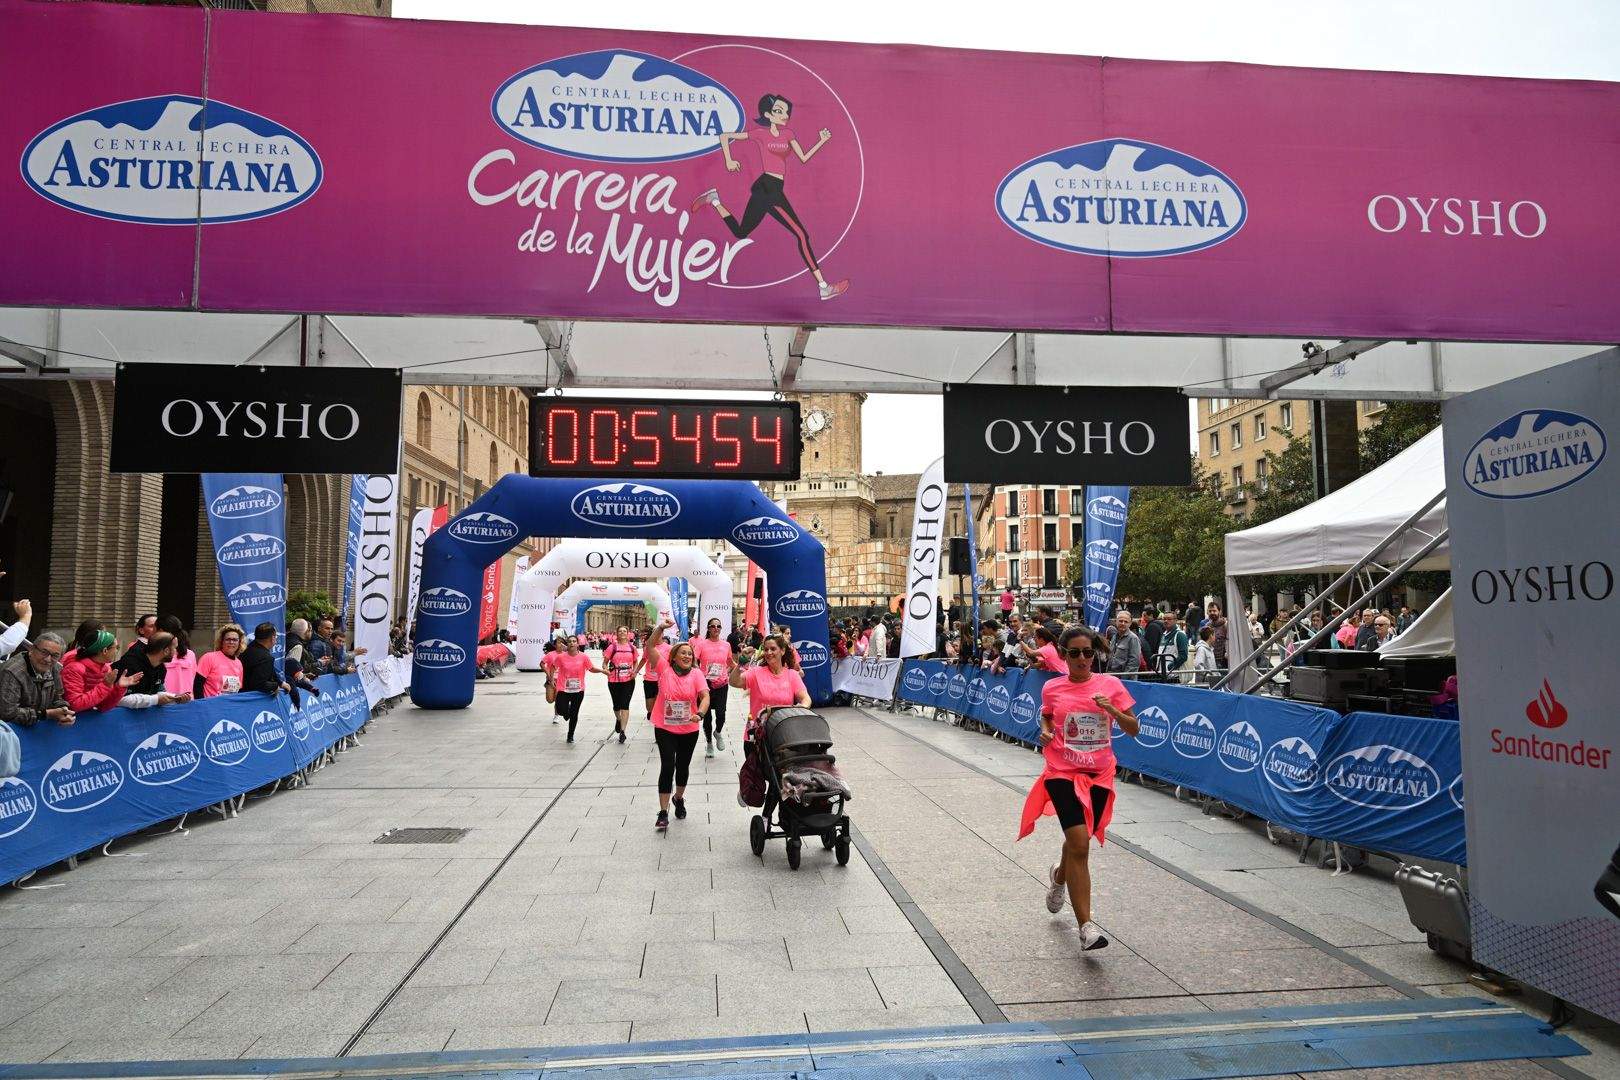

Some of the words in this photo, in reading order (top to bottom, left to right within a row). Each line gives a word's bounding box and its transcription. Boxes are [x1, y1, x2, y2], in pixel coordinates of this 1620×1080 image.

[552, 85, 631, 100] CENTRAL
[640, 90, 718, 104] LECHERA
[512, 86, 724, 137] ASTURIANA
[94, 137, 186, 153] CENTRAL
[195, 138, 291, 156] LECHERA
[44, 139, 299, 193] ASTURIANA
[467, 148, 678, 215] Carrera
[1055, 177, 1133, 191] CENTRAL
[1142, 180, 1219, 193] LECHERA
[1016, 179, 1229, 228] ASTURIANA
[1367, 193, 1548, 239] OYSHO
[518, 213, 557, 254] de
[566, 214, 594, 255] la
[587, 210, 754, 307] Mujer
[161, 398, 360, 441] OYSHO
[984, 418, 1156, 456] OYSHO
[1490, 440, 1534, 456] CENTRAL
[1537, 428, 1588, 447] LECHERA
[1472, 440, 1595, 485] ASTURIANA
[579, 495, 673, 517] ASTURIANA
[452, 522, 513, 537] ASTURIANA
[738, 528, 795, 540] ASTURIANA
[360, 473, 394, 624] OYSHO
[585, 551, 670, 569] OYSHO
[908, 483, 943, 621] OYSHO
[1471, 560, 1614, 606] OYSHO
[420, 597, 467, 611] ASTURIANA
[779, 601, 824, 613] ASTURIANA
[415, 649, 462, 662] ASTURIANA
[851, 659, 889, 680] OYSHO
[209, 739, 249, 759] ASTURIANA
[256, 727, 286, 746] ASTURIANA
[1174, 727, 1212, 750] ASTURIANA
[1491, 728, 1612, 770] Santander
[136, 751, 198, 778] ASTURIANA
[49, 770, 120, 804] ASTURIANA
[1330, 764, 1429, 798] ASTURIANA
